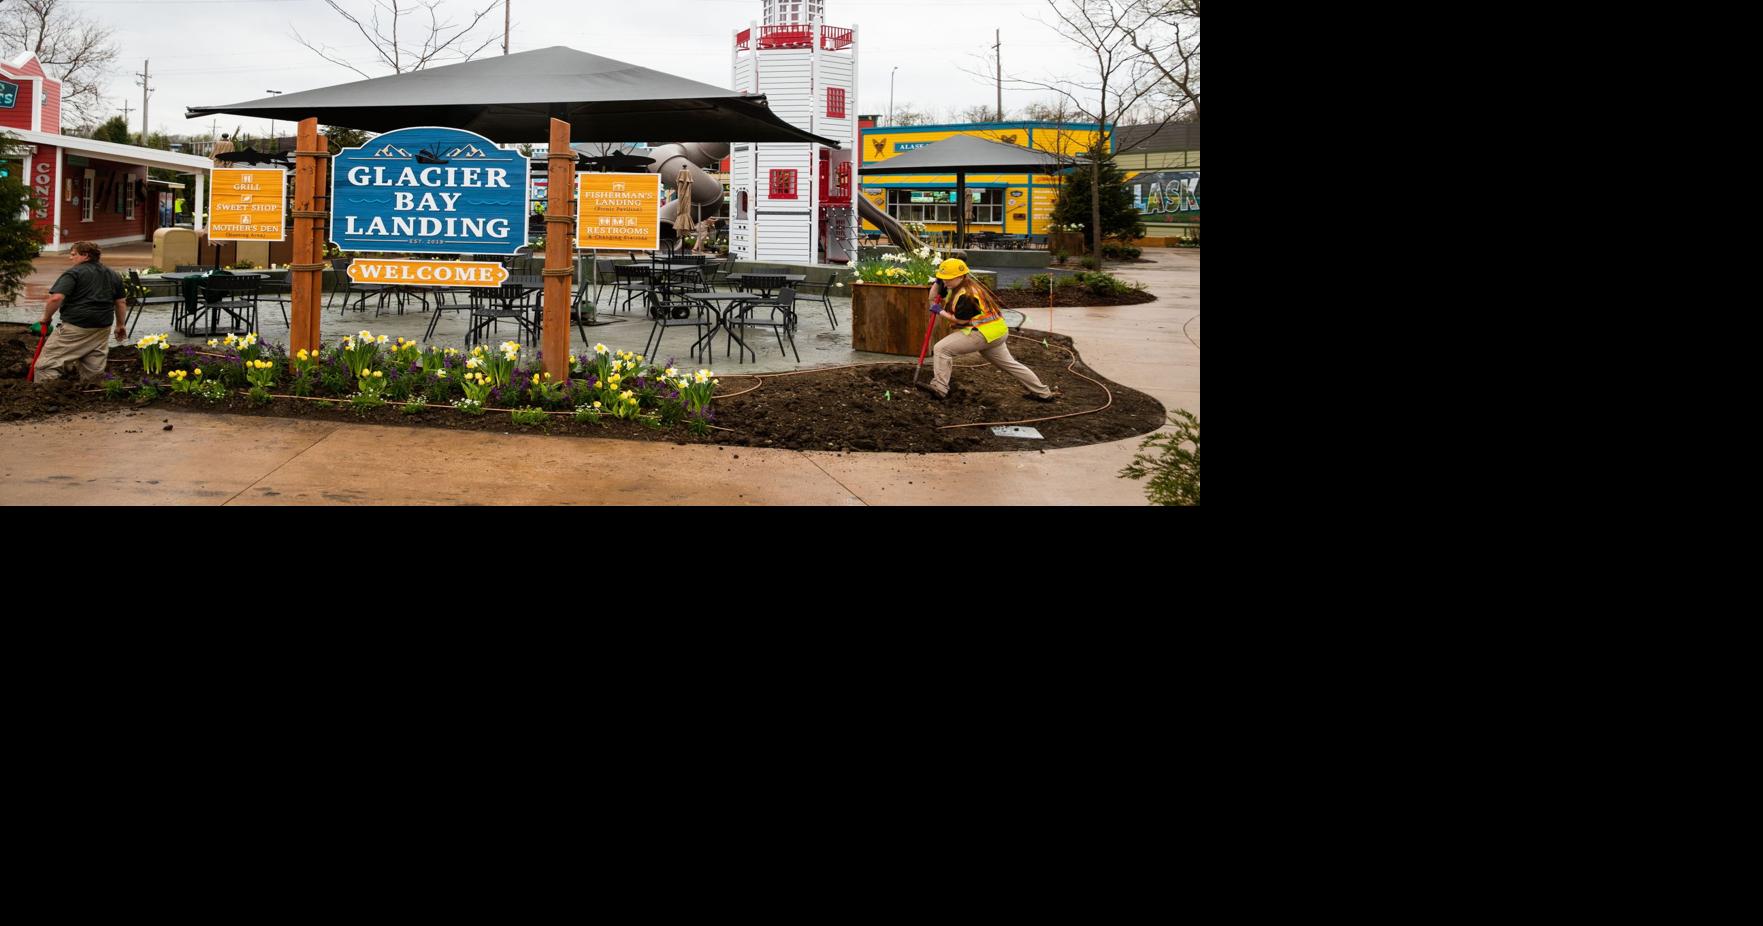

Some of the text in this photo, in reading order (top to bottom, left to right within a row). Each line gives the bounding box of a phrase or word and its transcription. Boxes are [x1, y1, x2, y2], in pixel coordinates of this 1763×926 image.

[347, 166, 511, 188] GLACIER
[233, 183, 261, 191] GRILL
[585, 191, 653, 199] FISHERMAN'S
[394, 192, 462, 212] BAY
[216, 203, 277, 212] SWEET SHOP
[213, 224, 258, 232] MOTHER'S
[345, 215, 511, 239] LANDING
[587, 226, 649, 235] RESTROOMS
[359, 264, 494, 283] WELCOME
